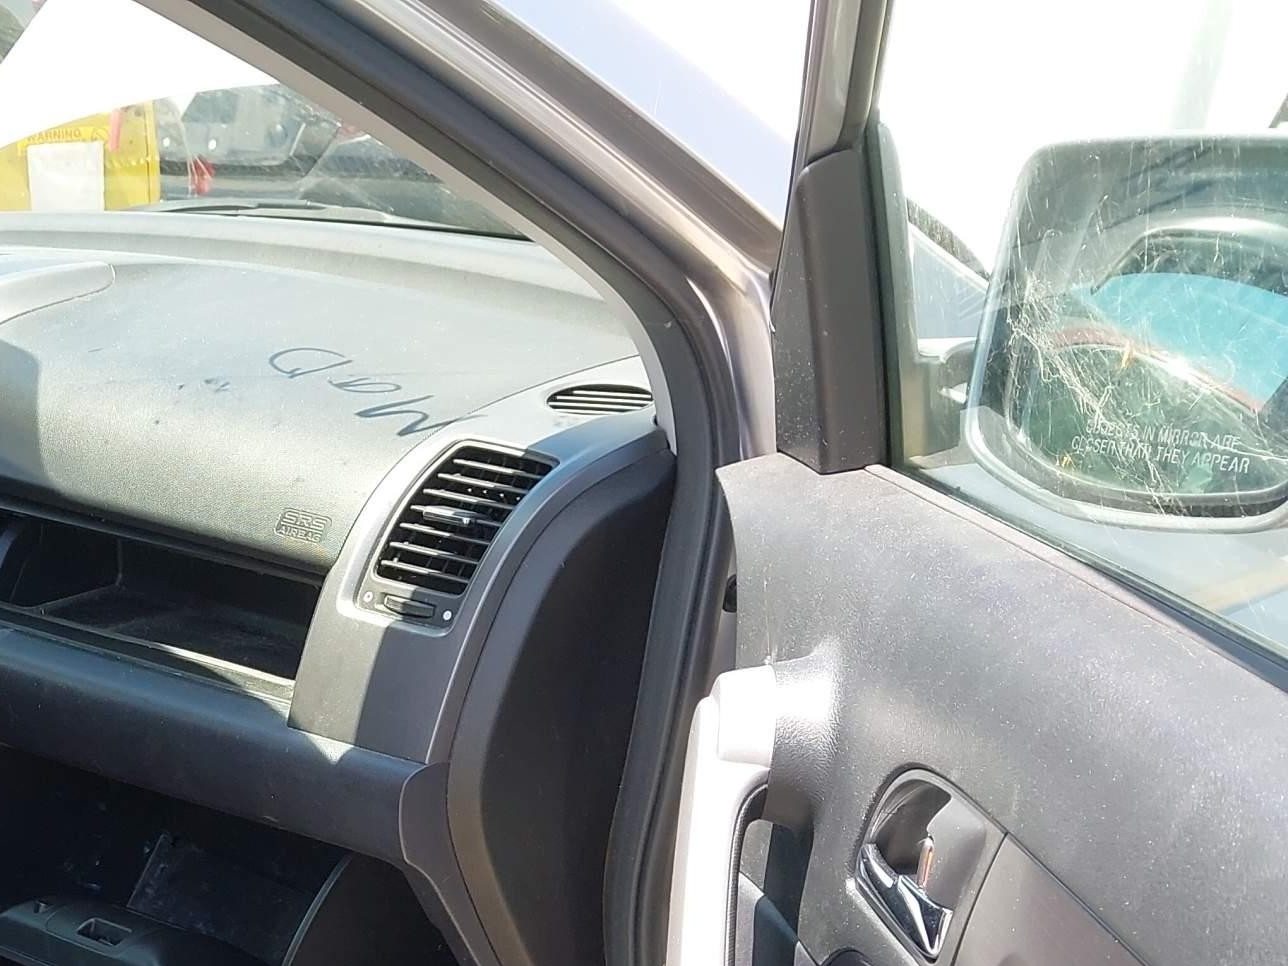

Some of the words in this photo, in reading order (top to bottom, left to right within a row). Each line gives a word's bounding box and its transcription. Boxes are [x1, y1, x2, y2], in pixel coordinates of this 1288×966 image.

[1142, 424, 1156, 441] IN
[1158, 426, 1208, 449] MIRROR
[1071, 435, 1116, 455] CLOSER
[1155, 445, 1191, 464] THEY
[1191, 451, 1250, 474] APPEAR
[281, 510, 327, 531] SRS
[276, 525, 323, 543] AIRBAG
